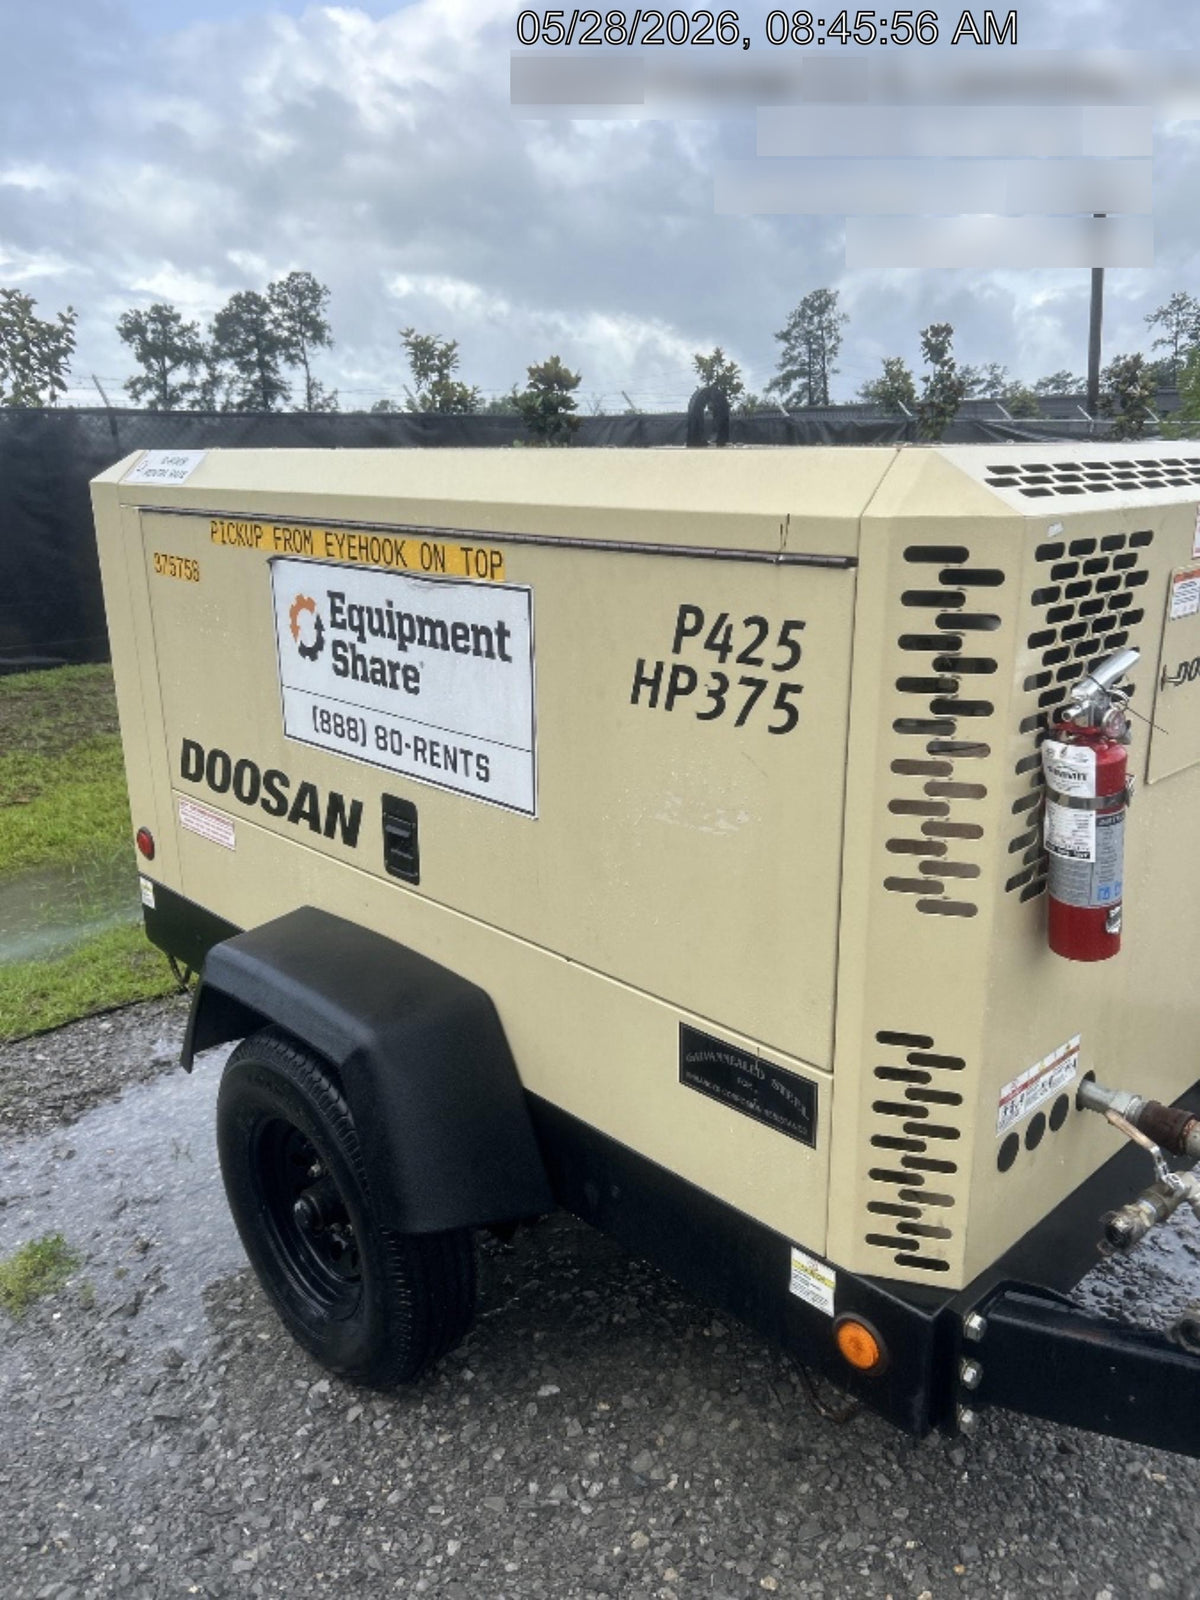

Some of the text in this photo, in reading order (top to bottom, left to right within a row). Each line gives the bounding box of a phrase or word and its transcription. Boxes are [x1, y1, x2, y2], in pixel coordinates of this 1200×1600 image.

[210, 520, 504, 580] PICKUP FROM EYEHOOK ON TOP
[326, 589, 513, 664] Equipment
[671, 603, 807, 673] P425
[331, 639, 421, 696] Share
[630, 657, 804, 735] HP375
[312, 704, 490, 783] (888) 80-RENTS
[180, 737, 364, 849] DOOSAN
